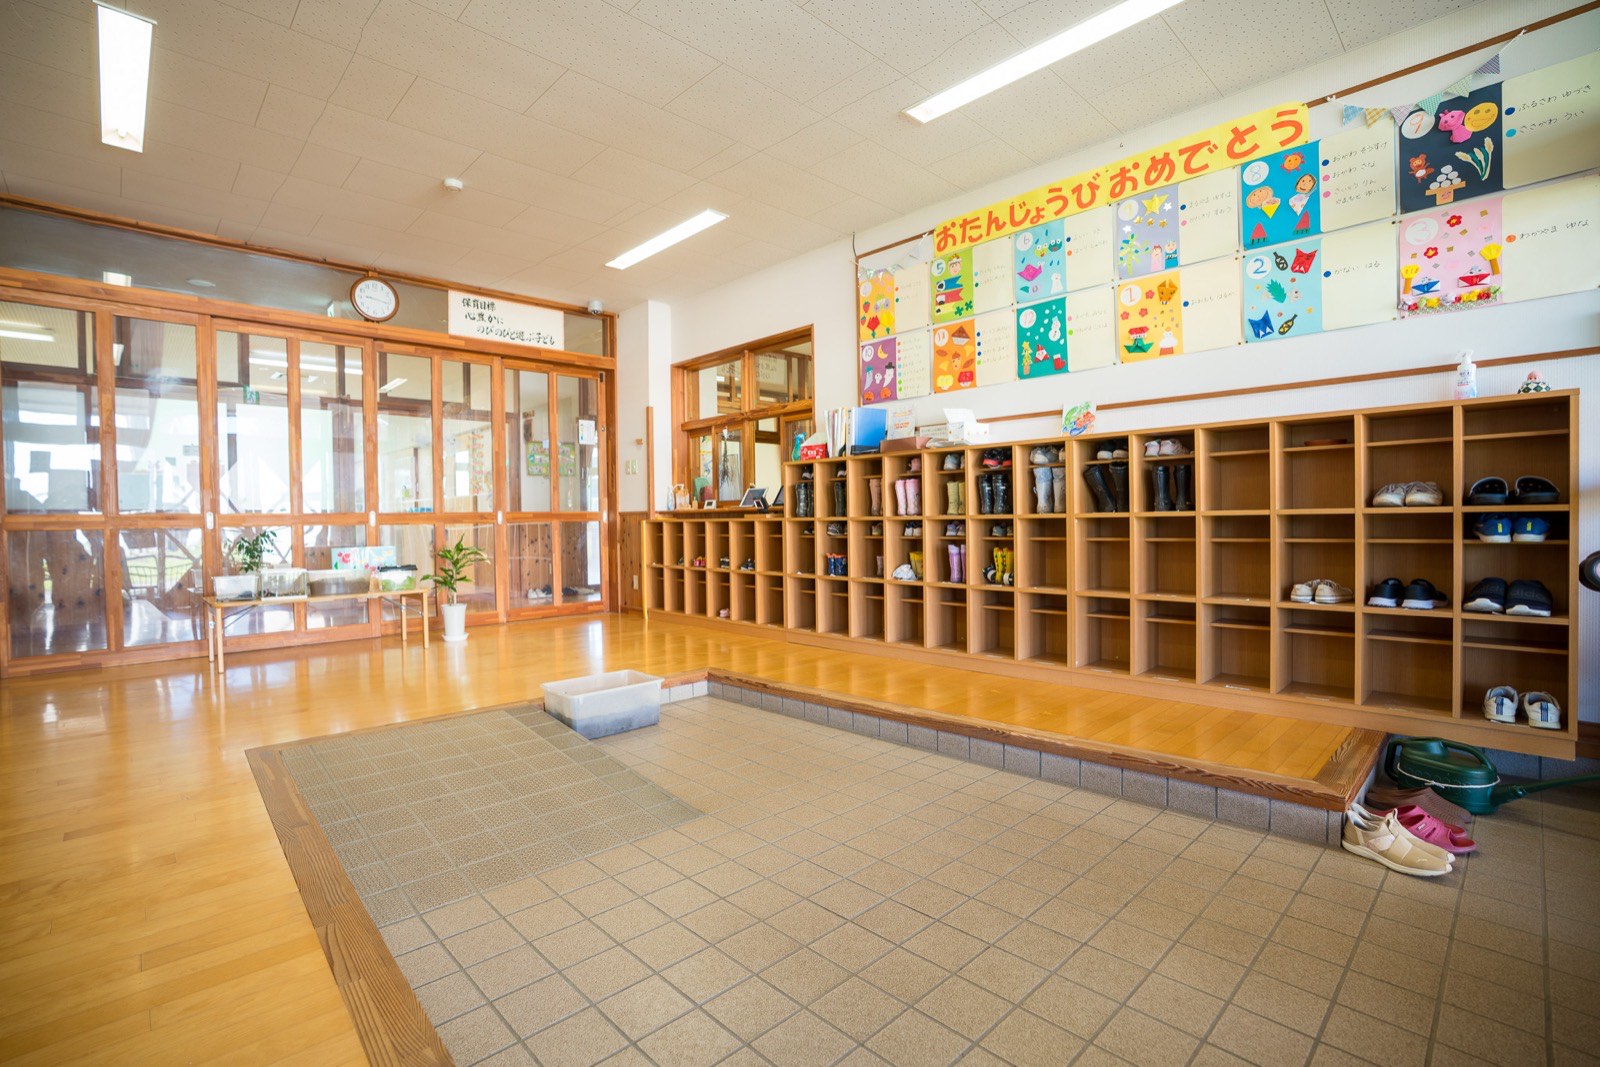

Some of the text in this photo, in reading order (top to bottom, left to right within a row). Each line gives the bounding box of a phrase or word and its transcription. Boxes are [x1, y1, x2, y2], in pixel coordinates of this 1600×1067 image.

[1409, 113, 1425, 134] 9
[1249, 164, 1262, 181] 8
[936, 109, 1304, 252] おたんじょうびおめでとう
[1023, 234, 1030, 245] 6
[936, 262, 944, 273] 5
[1252, 258, 1268, 274] 2
[1125, 287, 1136, 302] 1
[461, 297, 497, 312] 保育目標
